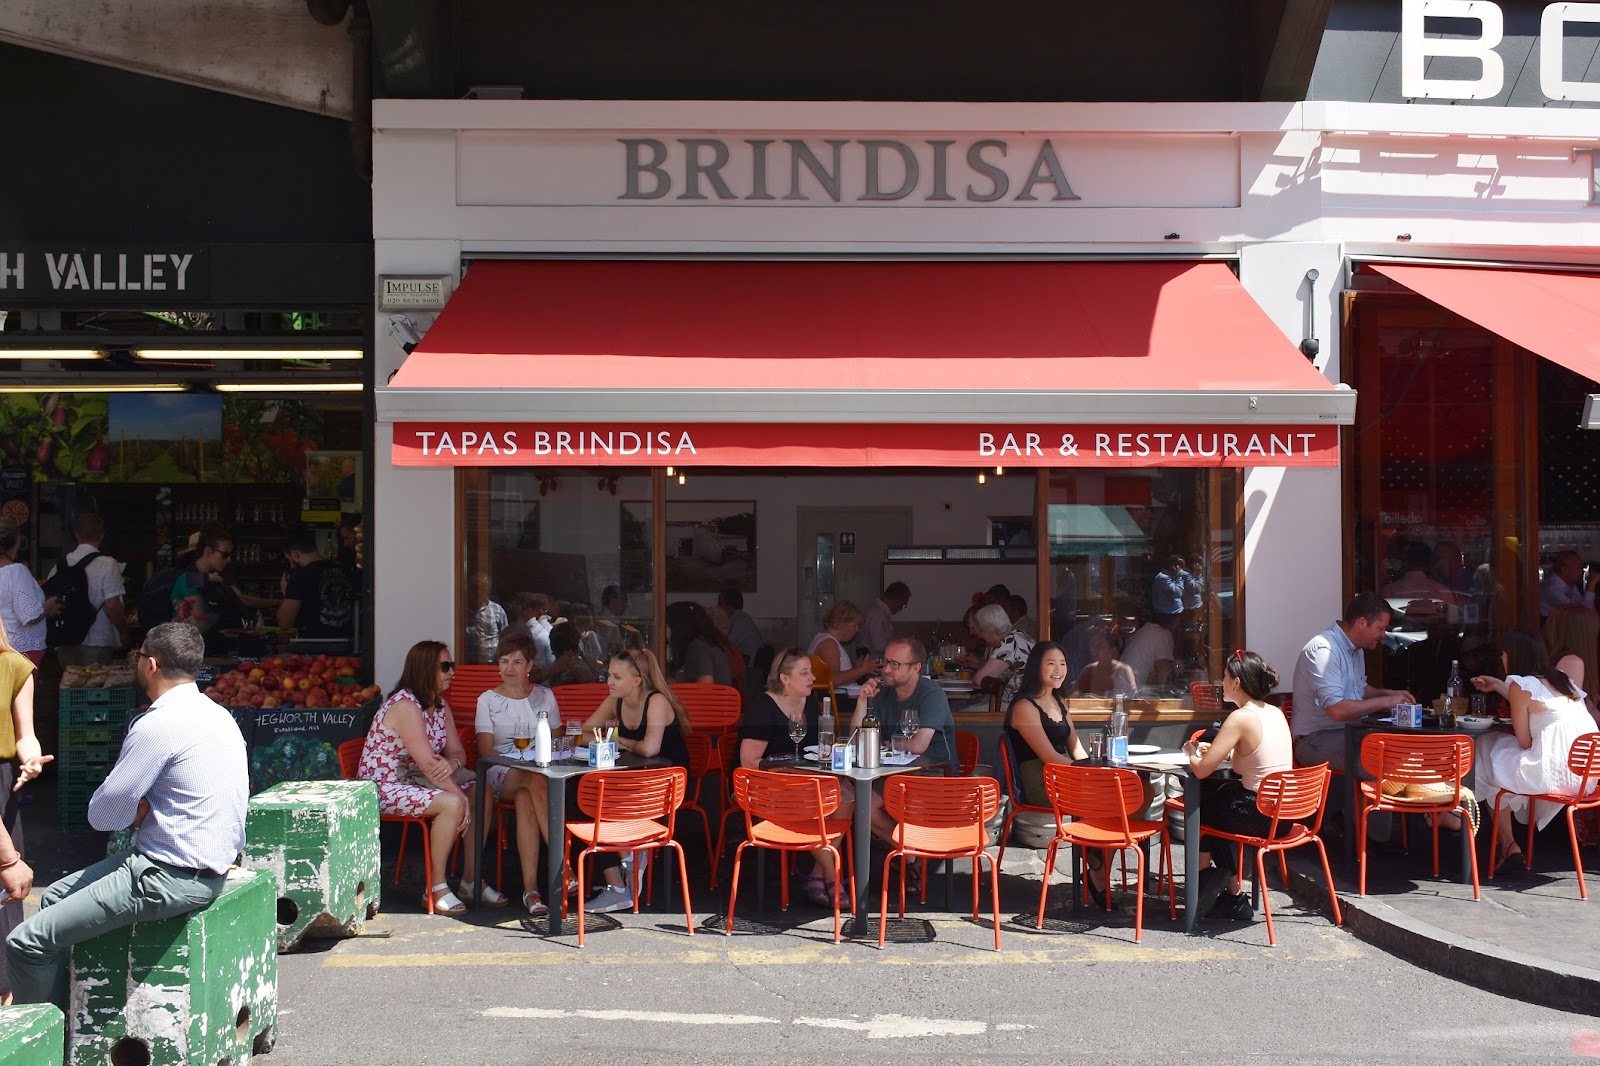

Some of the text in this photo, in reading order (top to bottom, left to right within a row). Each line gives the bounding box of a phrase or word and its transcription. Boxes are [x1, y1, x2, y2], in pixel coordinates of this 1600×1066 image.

[616, 138, 1082, 202] BRINDISA
[45, 252, 193, 291] VALLEY
[387, 281, 440, 293] IMPULSE
[416, 431, 698, 456] TAPAS BRINDISA
[978, 432, 1317, 457] BAR & RESTAURANT
[322, 712, 356, 728] VALLEY
